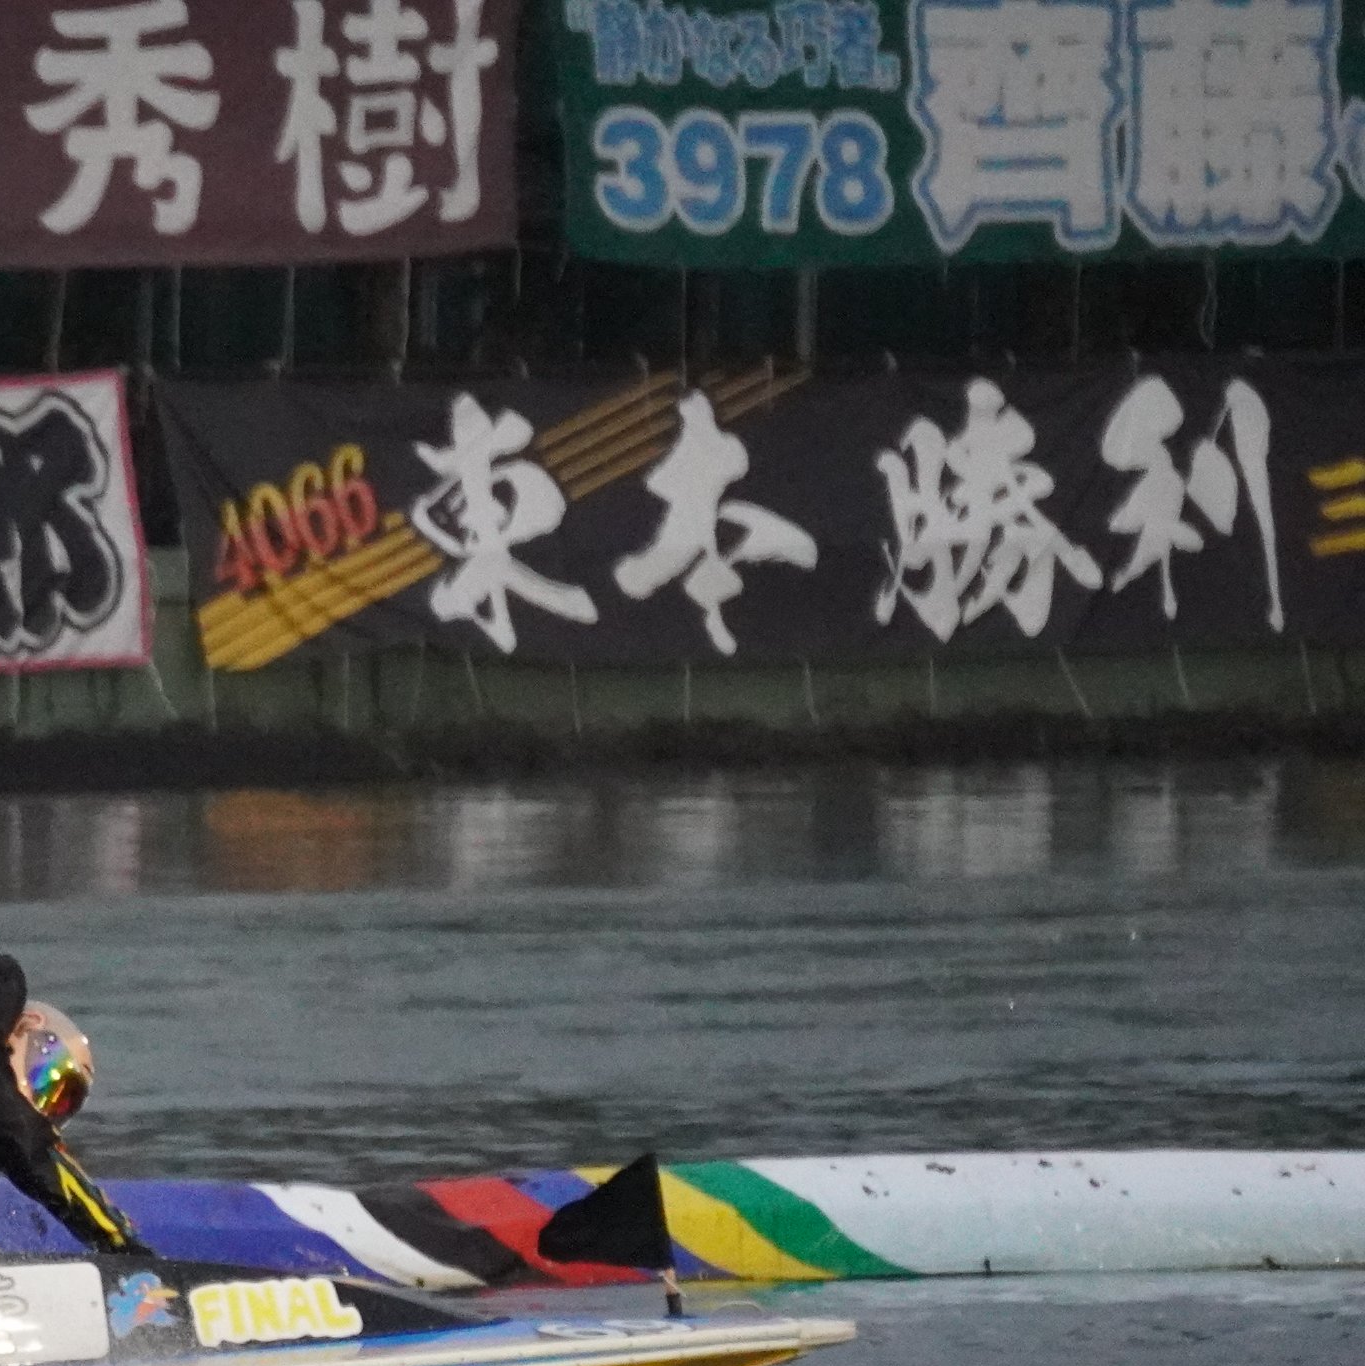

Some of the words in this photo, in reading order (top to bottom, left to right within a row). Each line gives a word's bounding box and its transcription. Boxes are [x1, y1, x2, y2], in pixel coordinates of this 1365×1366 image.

[595, 107, 894, 236] 3978
[214, 444, 379, 591] 4066
[413, 374, 1284, 656] 東本勝利
[189, 1278, 363, 1347] FINAL
